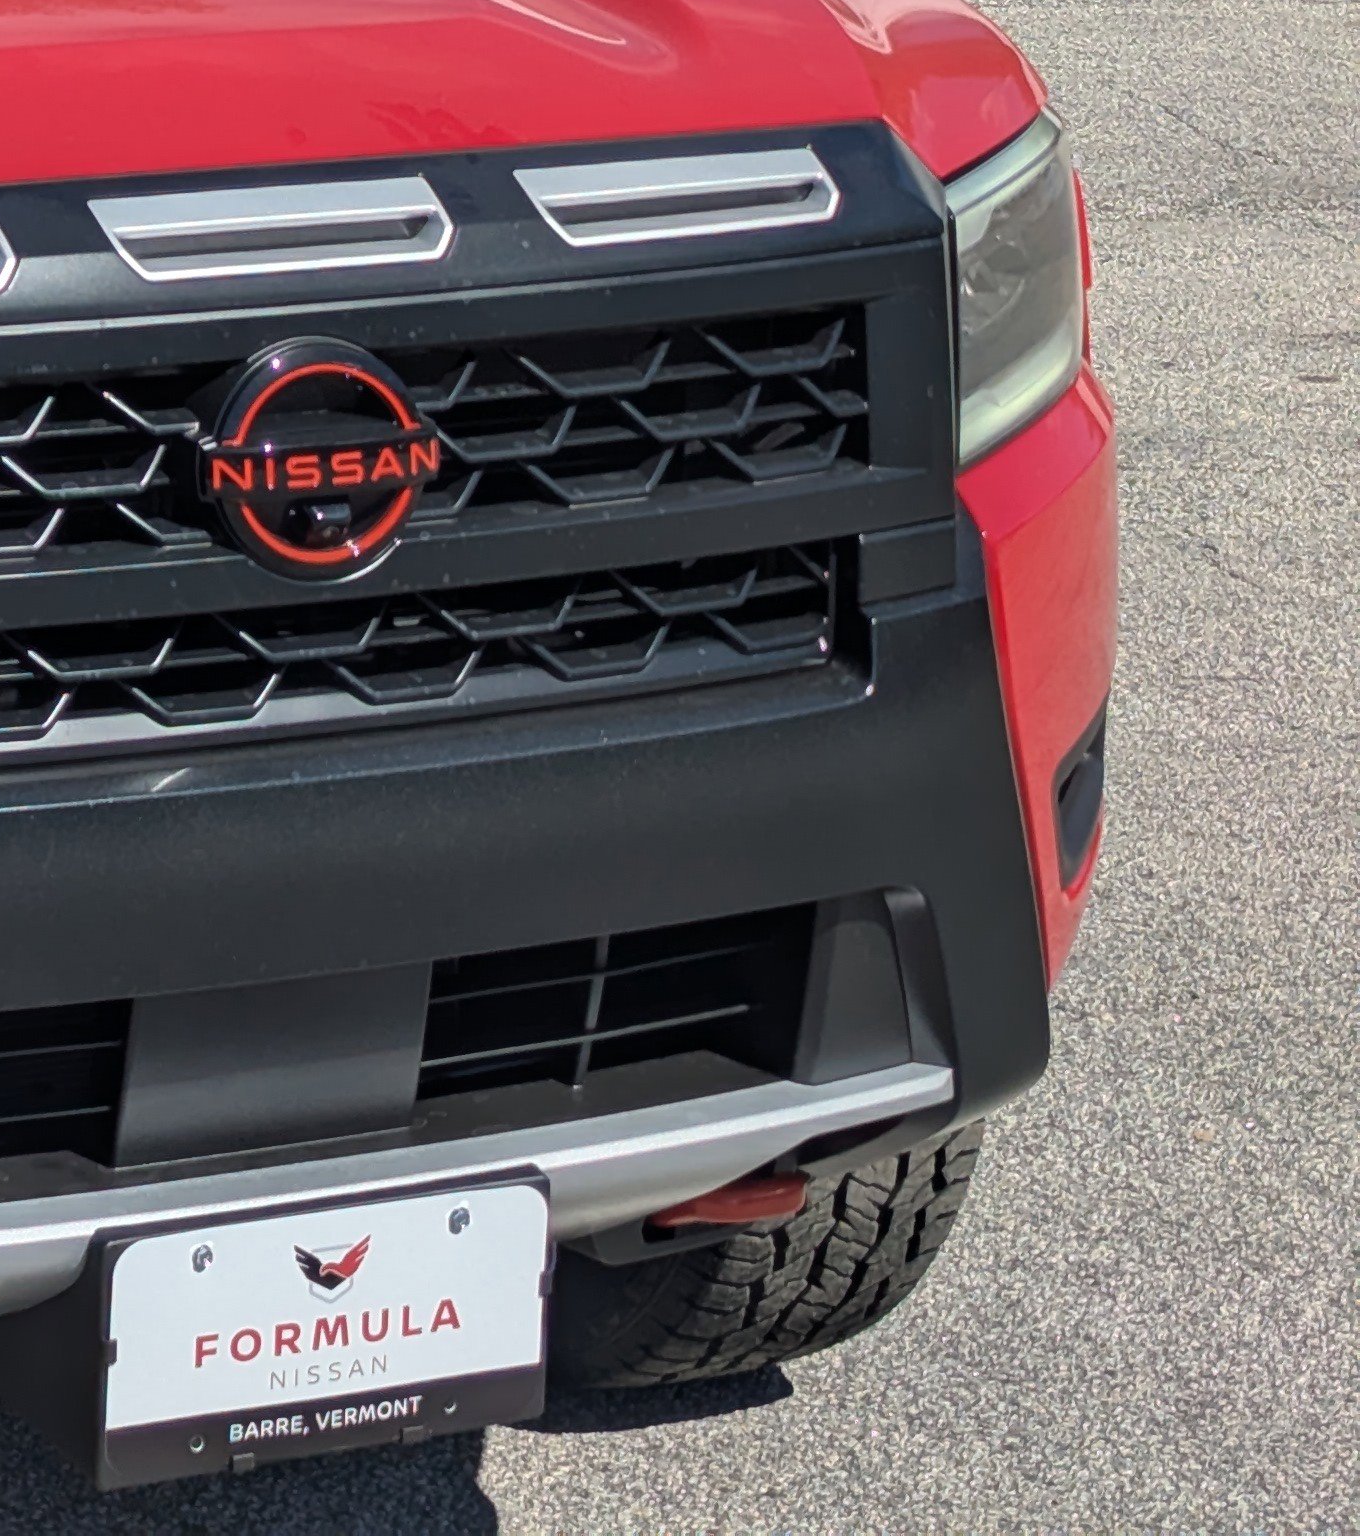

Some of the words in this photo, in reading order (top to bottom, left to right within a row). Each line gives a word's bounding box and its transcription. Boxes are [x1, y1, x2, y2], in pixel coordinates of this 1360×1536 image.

[209, 436, 441, 491] NISSAN
[194, 1298, 461, 1369] FORMULA
[270, 1354, 388, 1390] NISSAN
[229, 1414, 310, 1444] BARRE,
[315, 1394, 424, 1431] VERMONT
